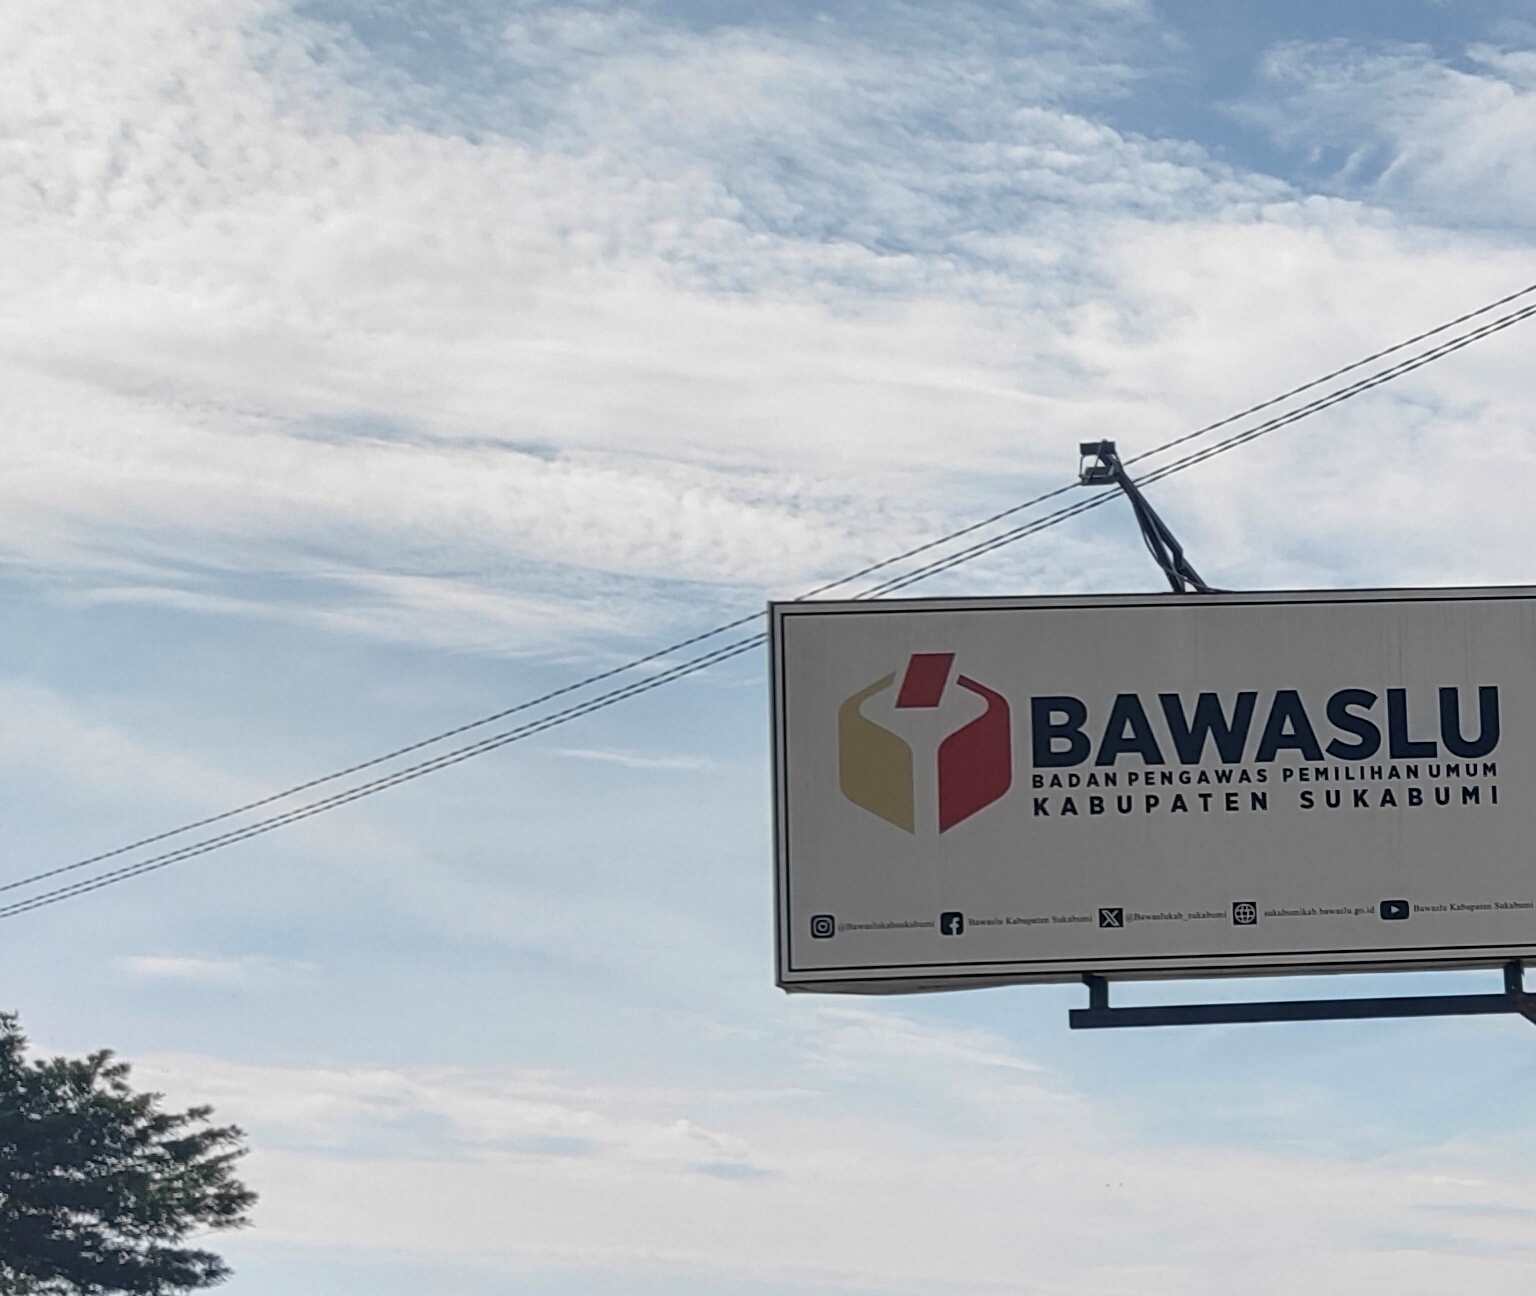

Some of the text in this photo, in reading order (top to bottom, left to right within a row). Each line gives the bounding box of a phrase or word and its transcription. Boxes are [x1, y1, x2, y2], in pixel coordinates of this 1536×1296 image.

[1030, 685, 1501, 768] BAWASLU
[1032, 762, 1498, 788] BADAN PENGAWAS PEMILIHAN UMUM
[1033, 785, 1498, 816] KABUPATEN SUKABUMI
